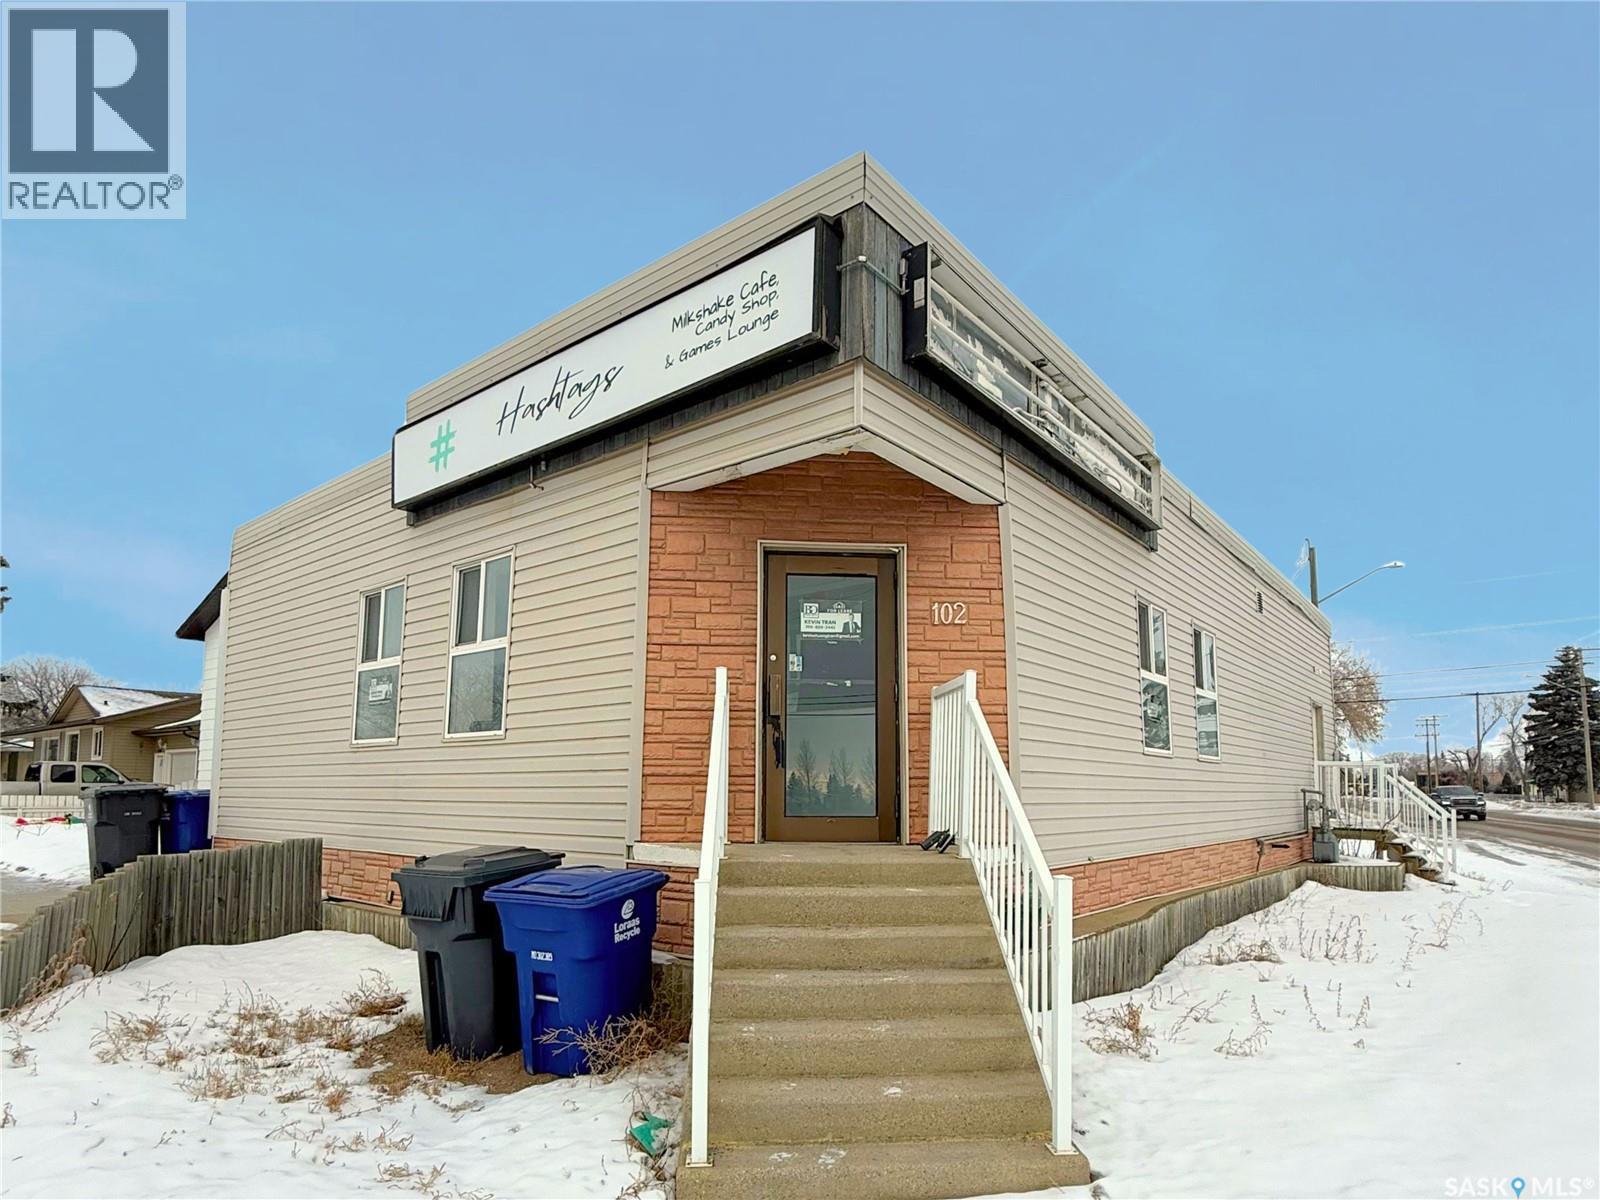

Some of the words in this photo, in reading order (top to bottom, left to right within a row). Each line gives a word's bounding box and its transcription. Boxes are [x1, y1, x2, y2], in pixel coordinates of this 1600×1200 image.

[739, 270, 780, 300] Cafe,
[695, 309, 736, 336] Candy
[664, 354, 675, 370] &
[678, 335, 722, 363] Games
[727, 309, 780, 341] Lounge
[496, 365, 624, 436] Hashtags
[931, 601, 969, 625] 102
[614, 917, 640, 934] Loraas
[614, 926, 641, 944] Recycle
